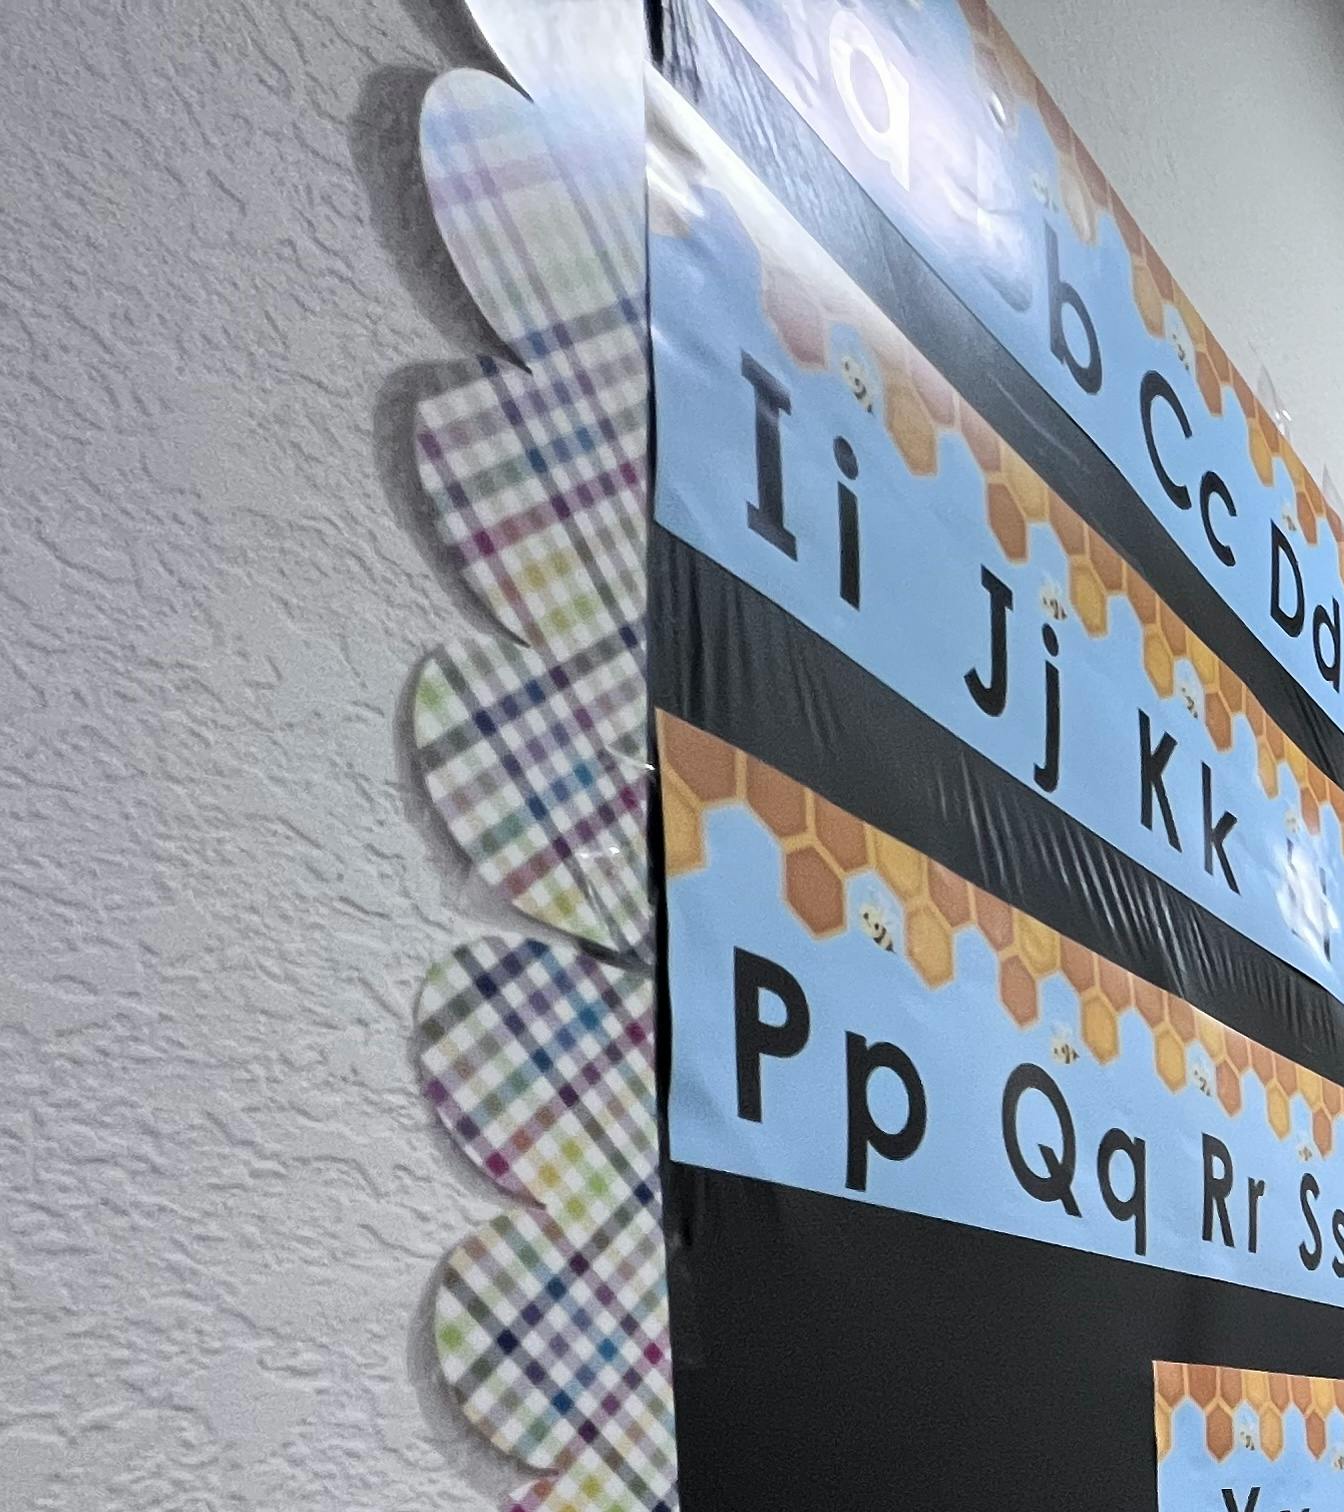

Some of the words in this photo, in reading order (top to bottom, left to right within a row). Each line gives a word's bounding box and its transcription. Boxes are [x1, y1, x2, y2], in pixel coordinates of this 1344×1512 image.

[741, 351, 861, 611] Ii
[964, 563, 1060, 793] Jj
[1138, 706, 1241, 897] Kk
[1139, 371, 1237, 567] Cc
[1271, 519, 1340, 694] Dd
[734, 946, 927, 1192] Pp
[1002, 1062, 1147, 1256] Qq
[1201, 1132, 1265, 1254] Rr
